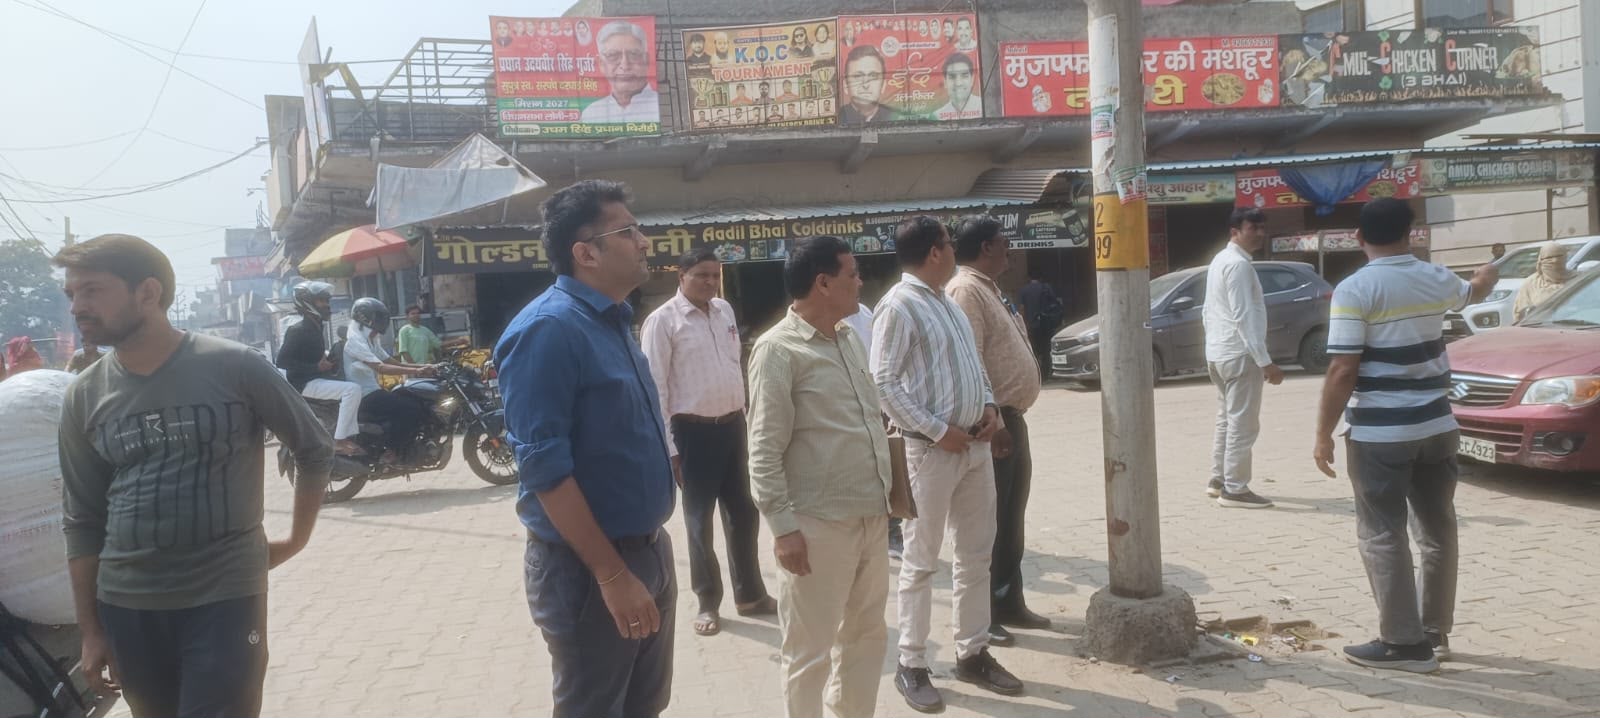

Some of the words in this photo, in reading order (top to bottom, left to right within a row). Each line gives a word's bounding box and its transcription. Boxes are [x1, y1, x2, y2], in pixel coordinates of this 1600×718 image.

[734, 44, 789, 63] K.O.C
[1164, 40, 1197, 72] की
[1202, 47, 1273, 80] मशहूर
[712, 63, 812, 81] TOURNAMENT
[546, 99, 569, 108] 2027
[703, 226, 745, 243] Aadil
[749, 222, 787, 239] Bhai
[792, 218, 864, 238] Coldrinks
[433, 235, 549, 265] गोल्डन
